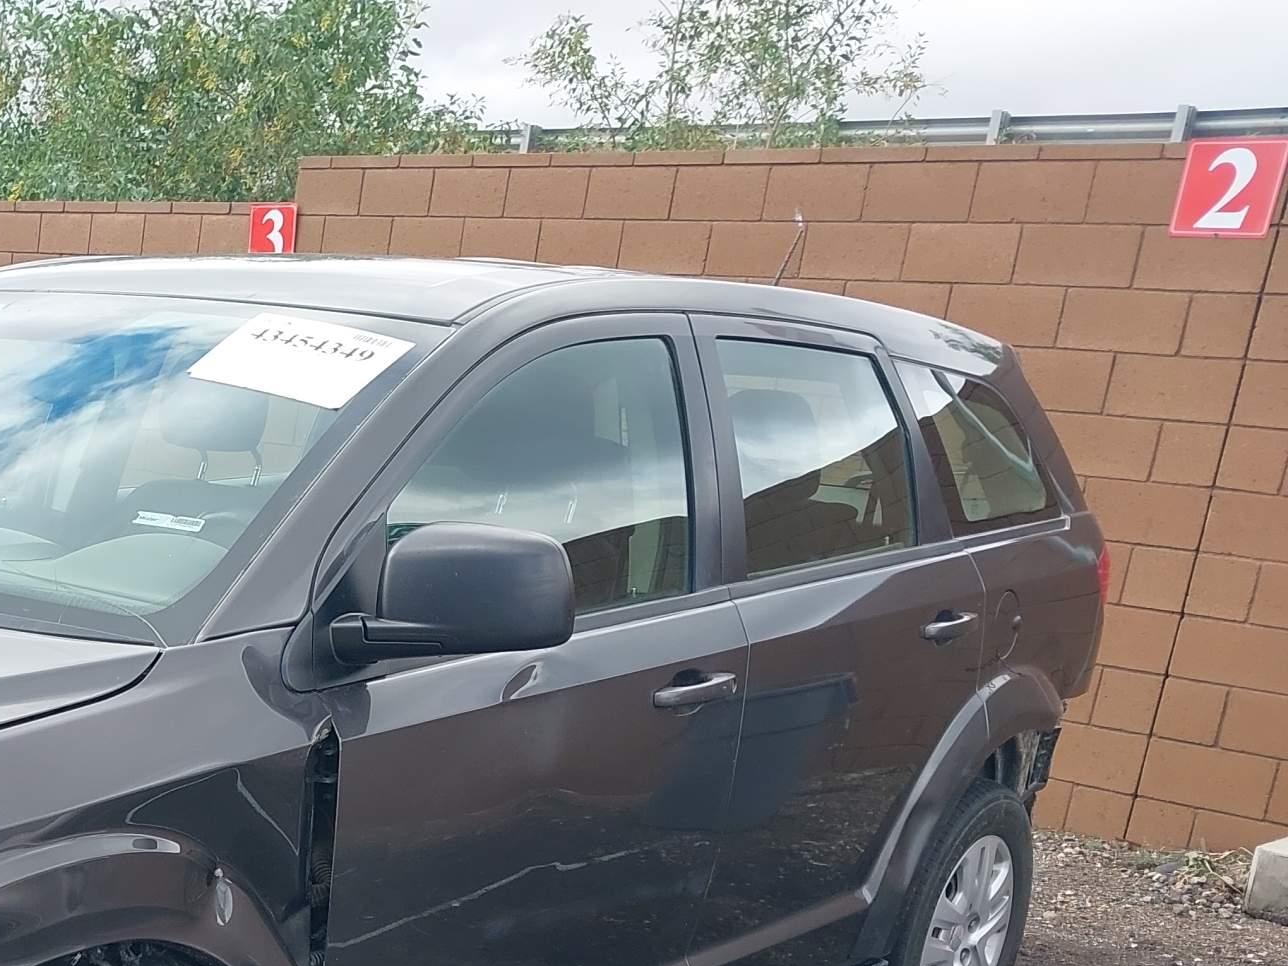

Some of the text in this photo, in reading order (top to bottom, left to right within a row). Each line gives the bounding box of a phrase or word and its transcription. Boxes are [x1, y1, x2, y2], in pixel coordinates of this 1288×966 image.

[1193, 147, 1258, 229] 2
[261, 208, 284, 254] 3
[249, 327, 376, 362] 43454349
